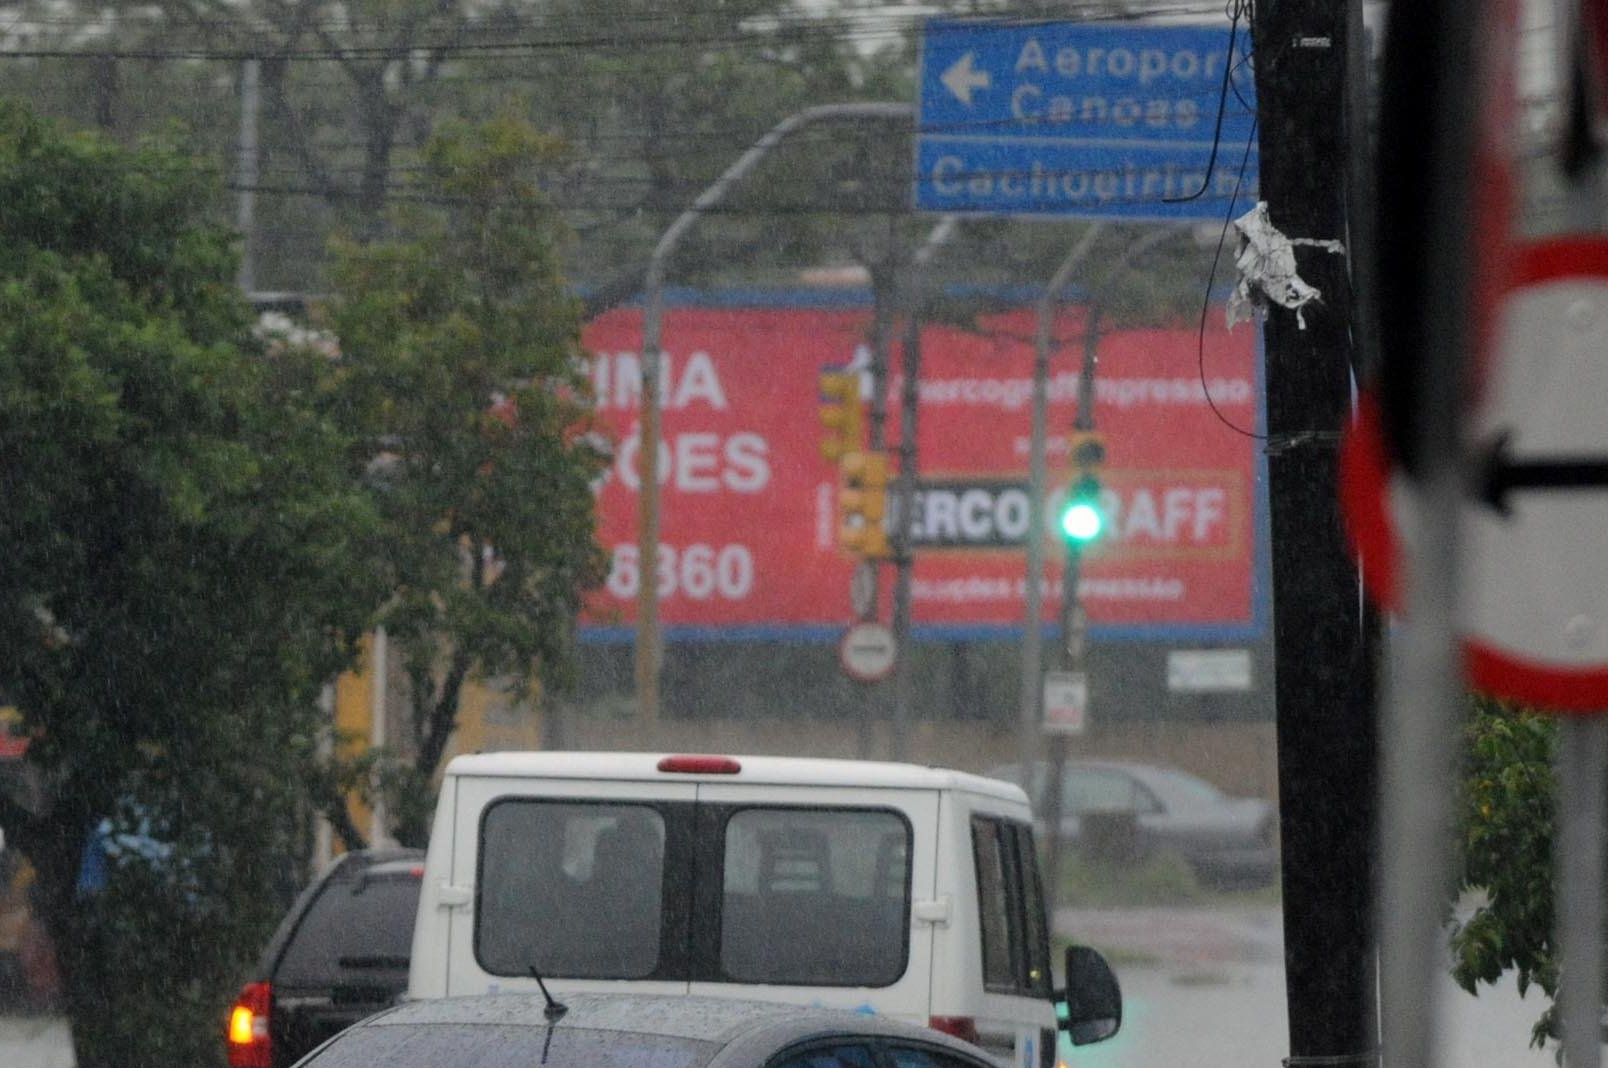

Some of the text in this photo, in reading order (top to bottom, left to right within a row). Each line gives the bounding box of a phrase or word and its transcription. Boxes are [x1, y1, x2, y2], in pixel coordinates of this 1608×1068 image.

[1011, 85, 1199, 127] Canoas
[933, 156, 1258, 198] Cachoeirinh
[576, 352, 727, 409] IMA
[877, 490, 1030, 538] ERCO
